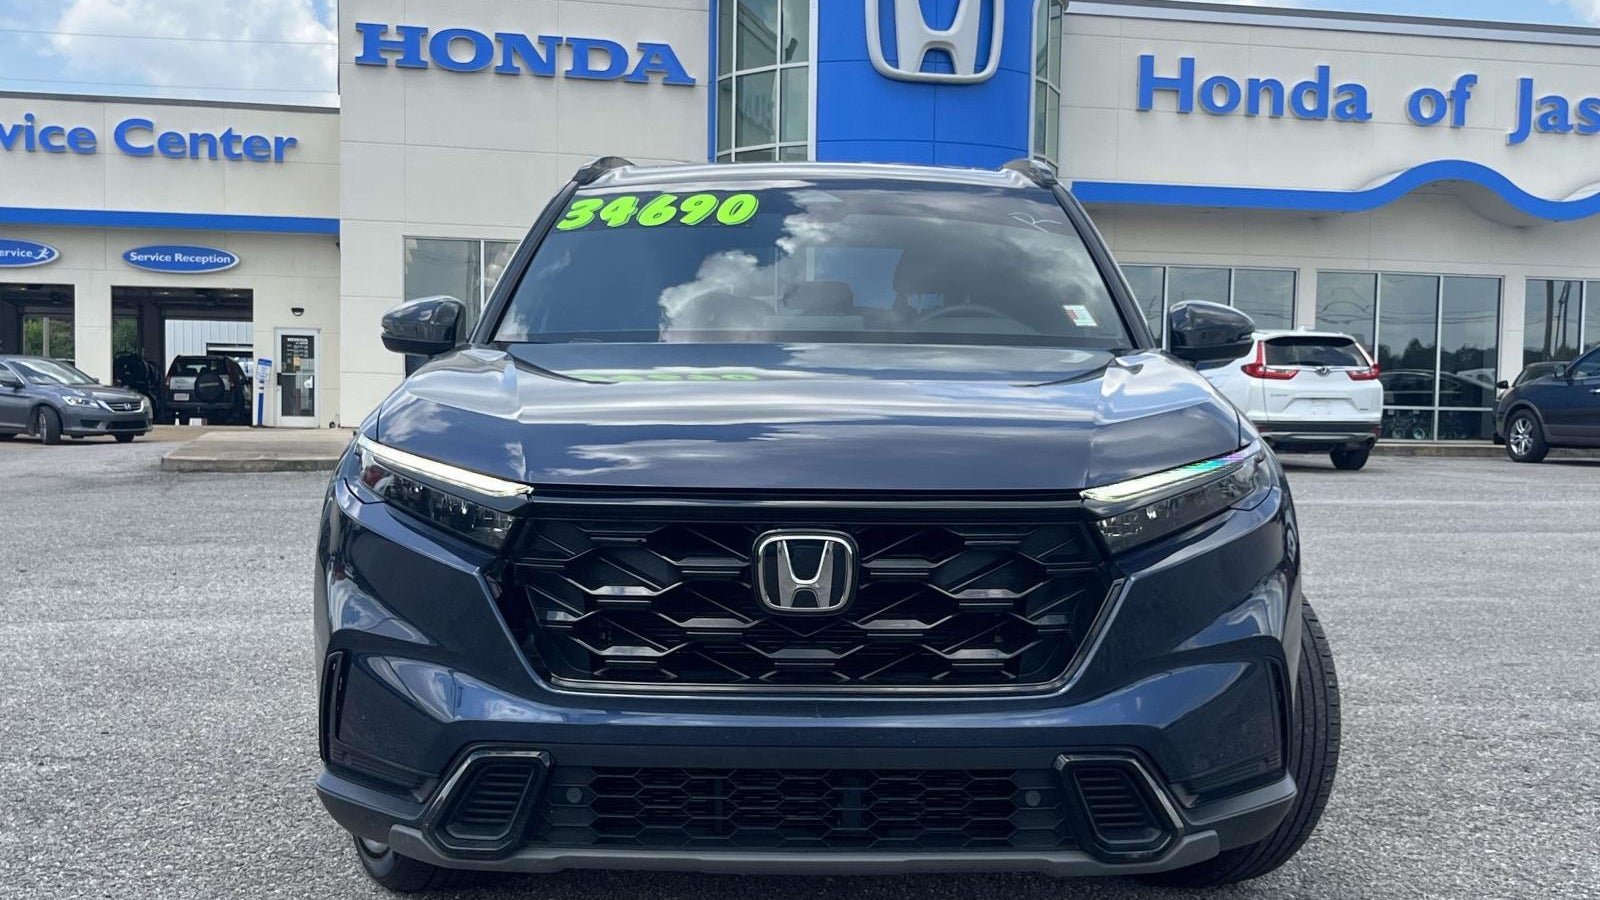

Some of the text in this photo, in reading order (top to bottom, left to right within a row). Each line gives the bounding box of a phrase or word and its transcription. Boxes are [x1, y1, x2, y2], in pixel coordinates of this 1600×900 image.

[355, 22, 696, 85] HONDA
[1137, 54, 1600, 145] Honda of Jas
[0, 112, 297, 163] vice Center
[556, 193, 759, 230] 34690
[129, 252, 231, 264] Service Reception
